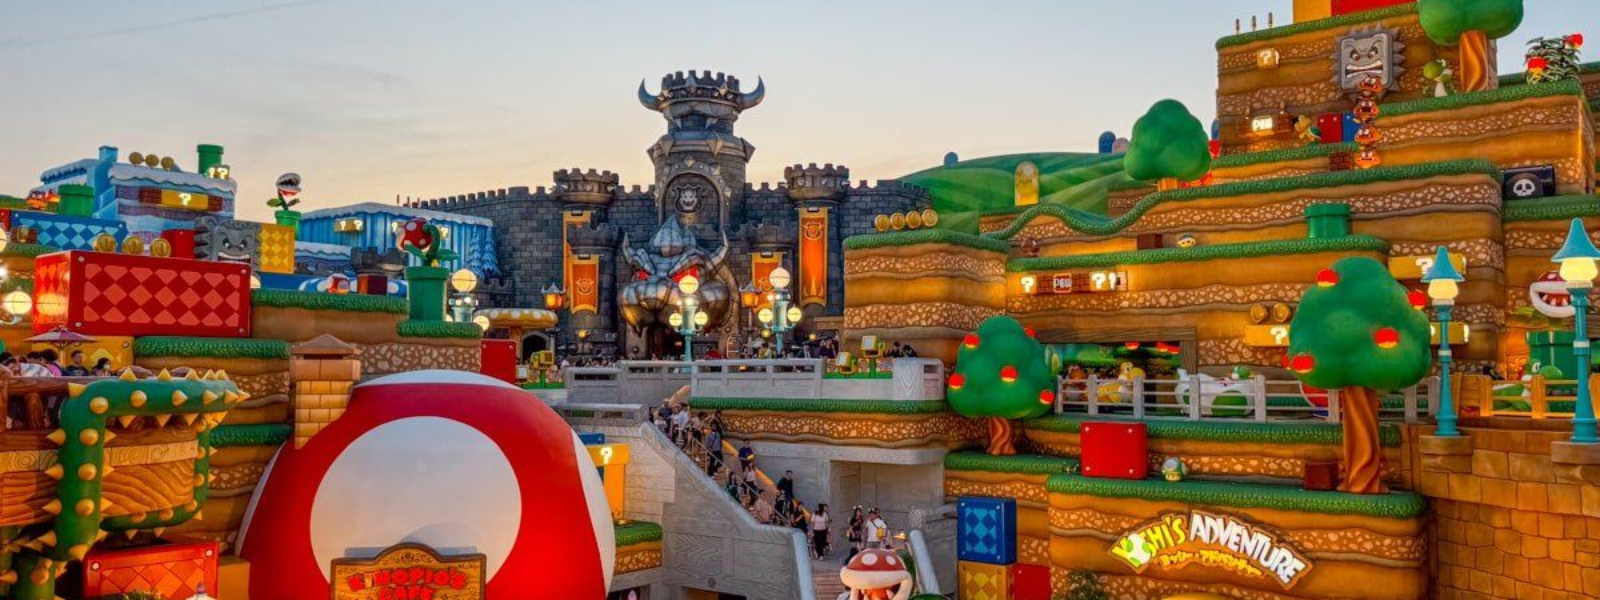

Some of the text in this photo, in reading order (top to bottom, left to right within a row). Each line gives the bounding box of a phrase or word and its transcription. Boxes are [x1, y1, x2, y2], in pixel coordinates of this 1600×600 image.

[1053, 278, 1073, 289] POW
[1111, 511, 1306, 584] YOSHI'S ADVENTURE
